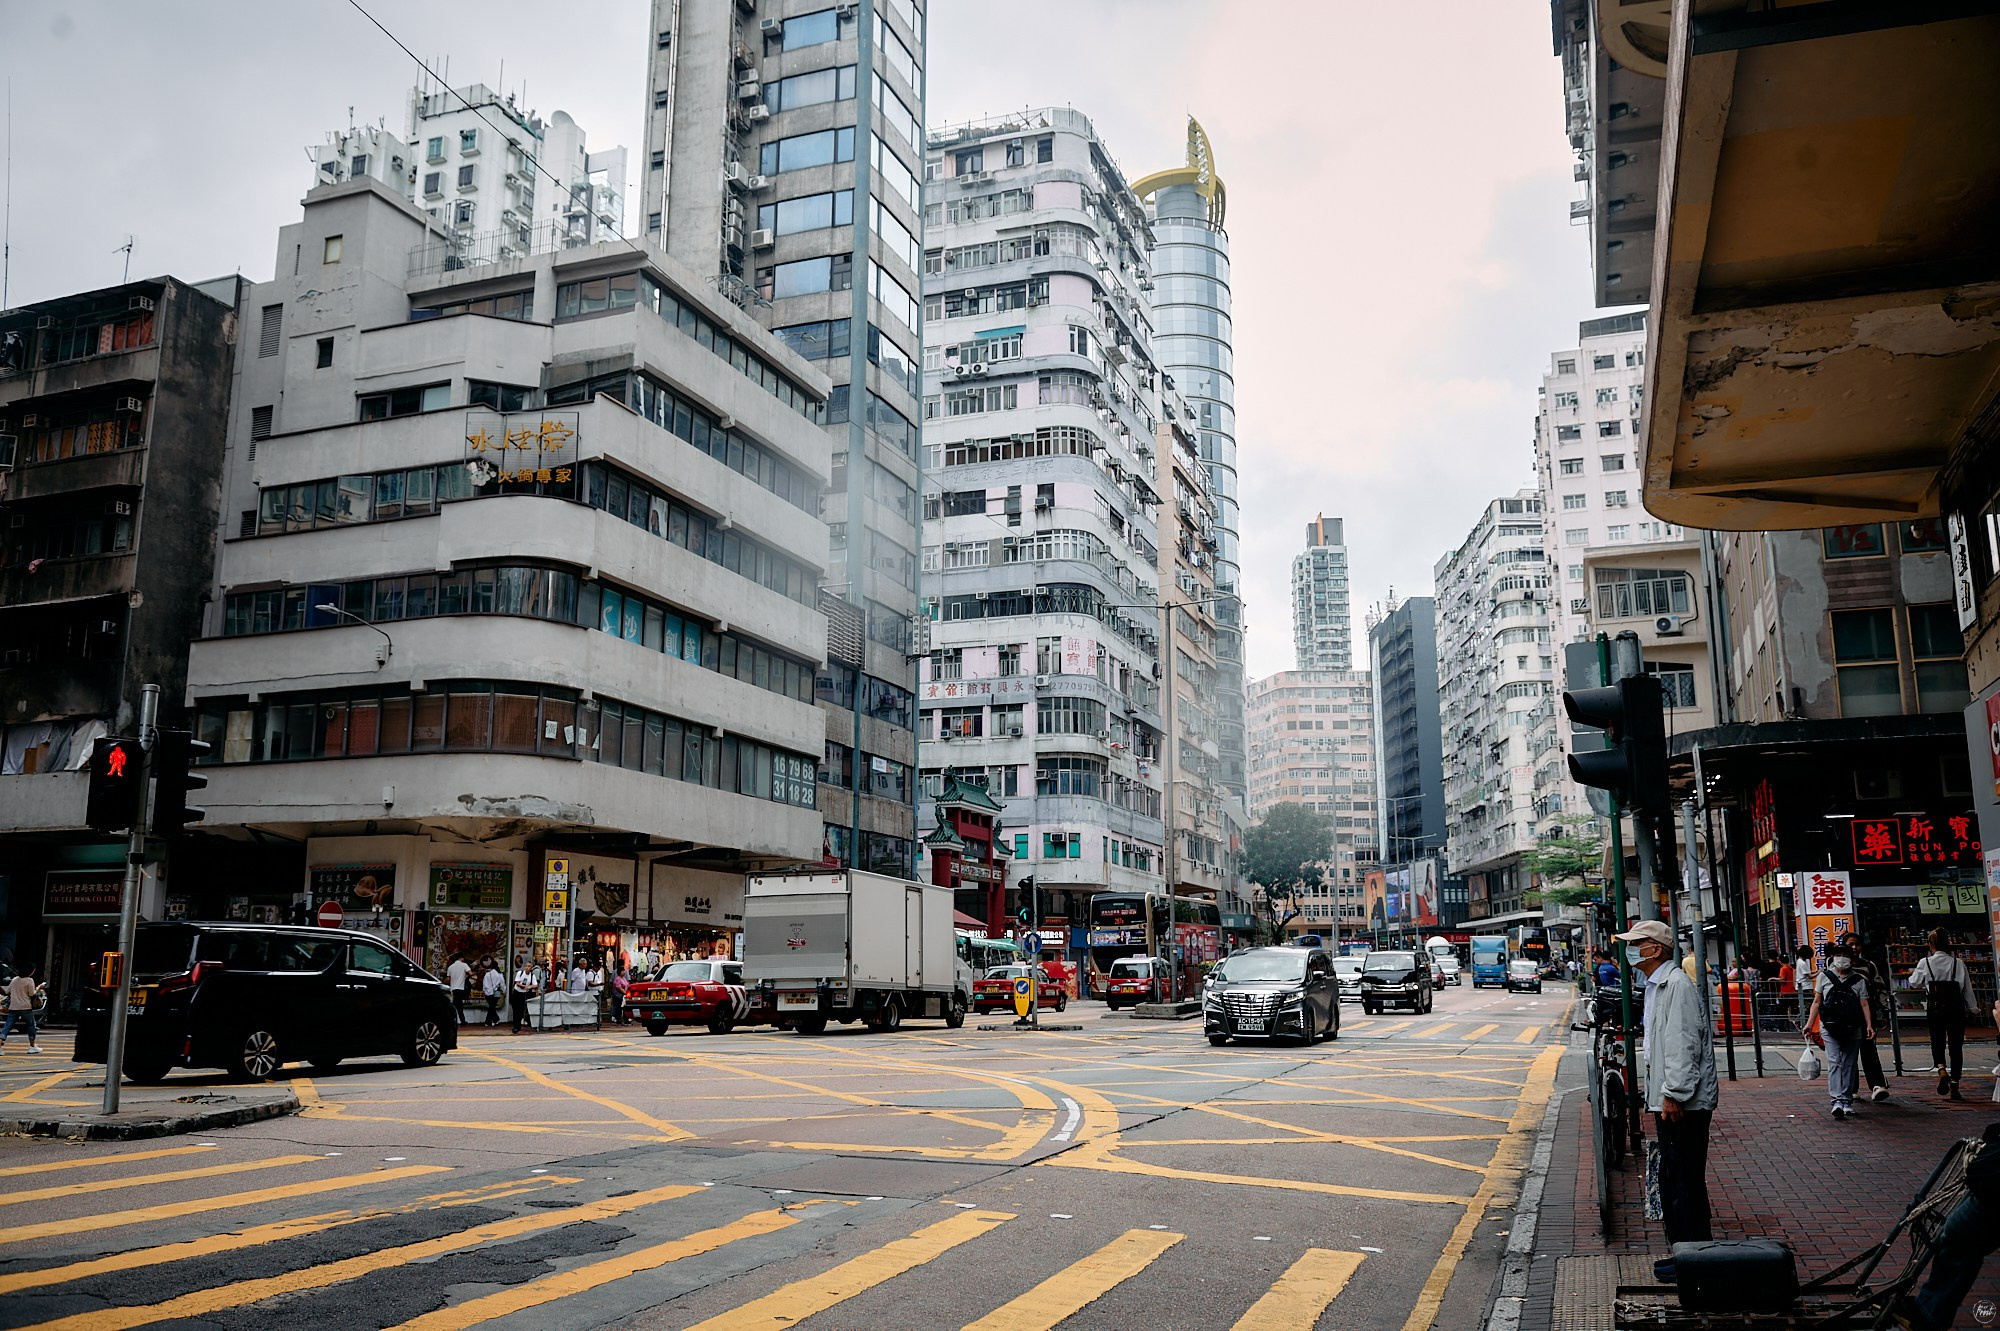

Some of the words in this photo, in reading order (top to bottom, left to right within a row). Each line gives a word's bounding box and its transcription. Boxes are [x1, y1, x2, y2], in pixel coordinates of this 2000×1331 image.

[498, 467, 573, 484] 火鍋專家
[774, 755, 786, 774] 16
[788, 759, 801, 778] 79
[802, 763, 815, 781] 68
[773, 780, 786, 798] 31
[788, 784, 800, 802] 18
[801, 787, 814, 805] 28
[1908, 843, 1942, 852] SUN
[1812, 873, 1847, 910] 藥
[1920, 886, 1944, 910] 寄
